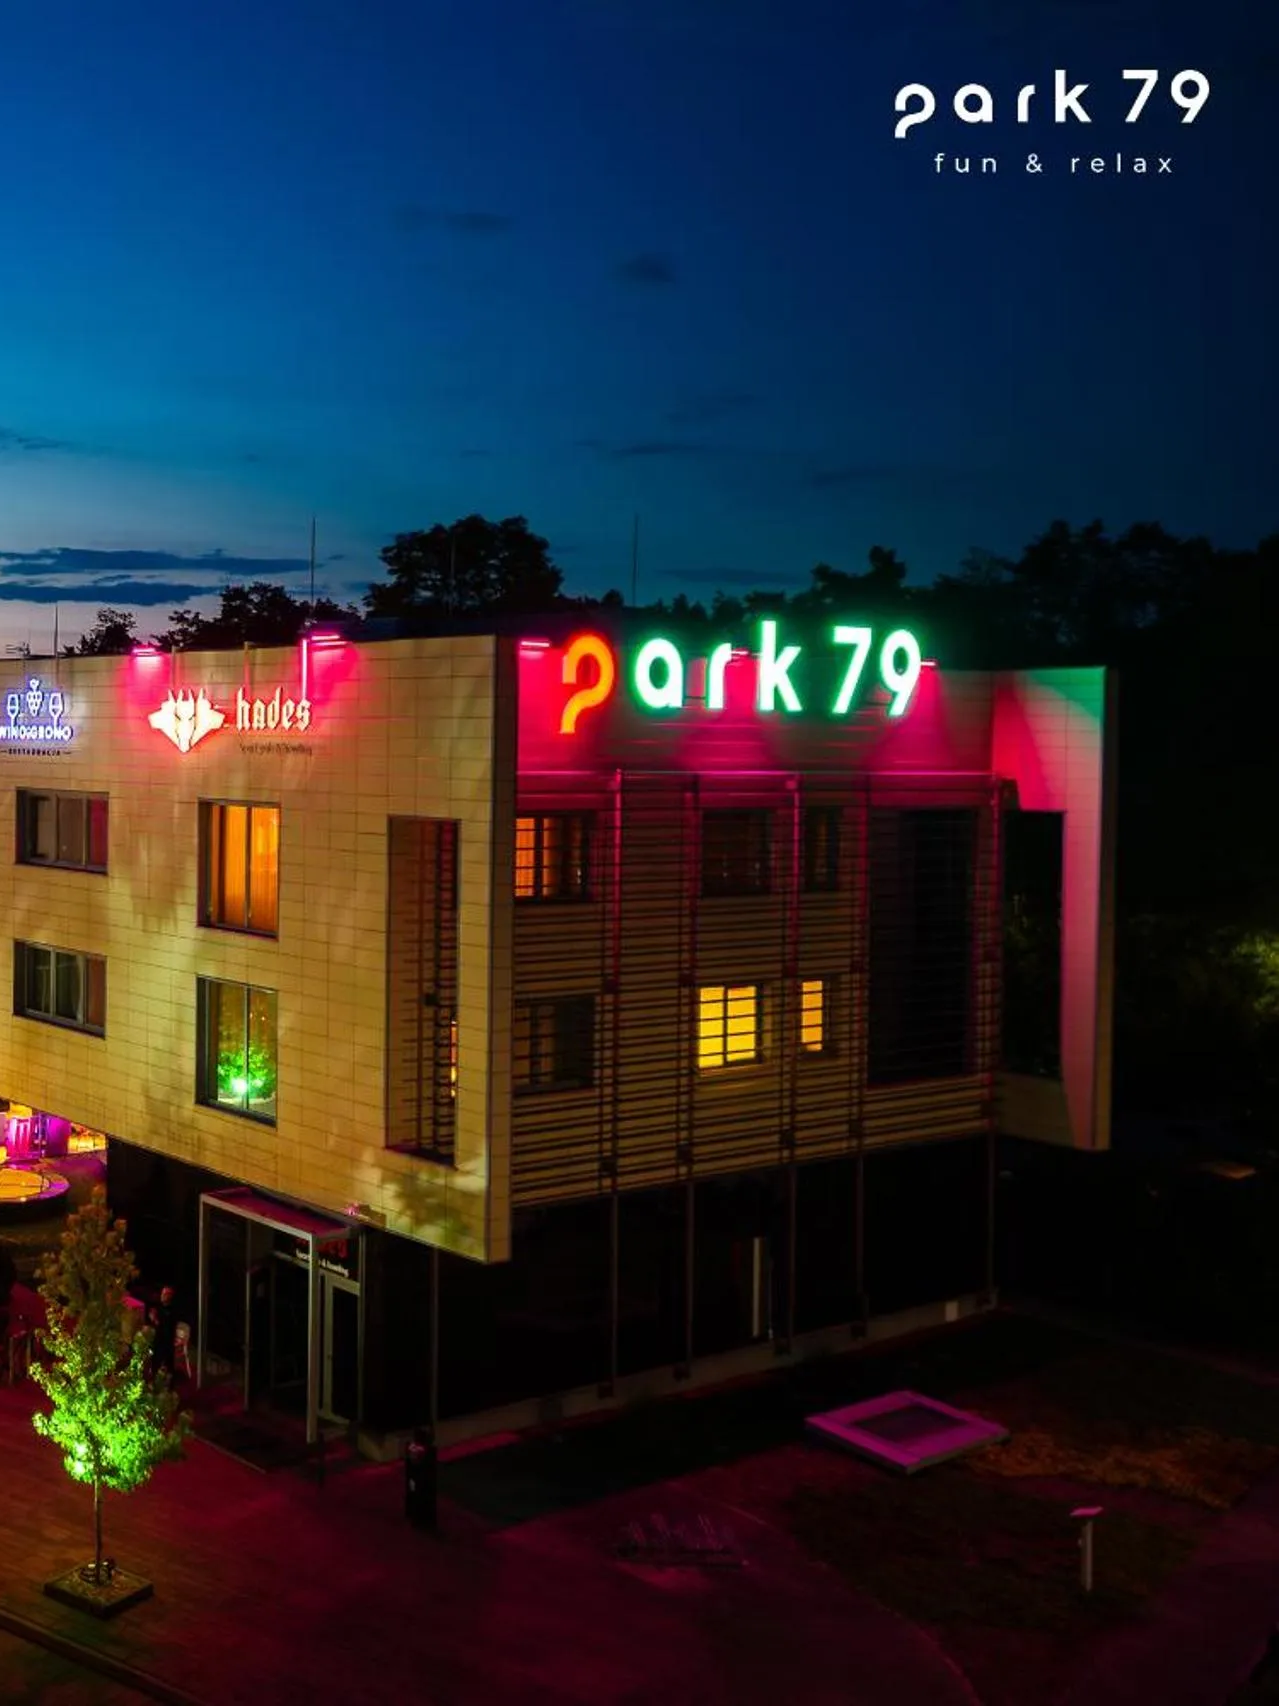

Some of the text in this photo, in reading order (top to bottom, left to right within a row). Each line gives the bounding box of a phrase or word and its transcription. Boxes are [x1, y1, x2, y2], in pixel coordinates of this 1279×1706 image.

[236, 686, 312, 732] hades
[559, 620, 922, 734] park 79
